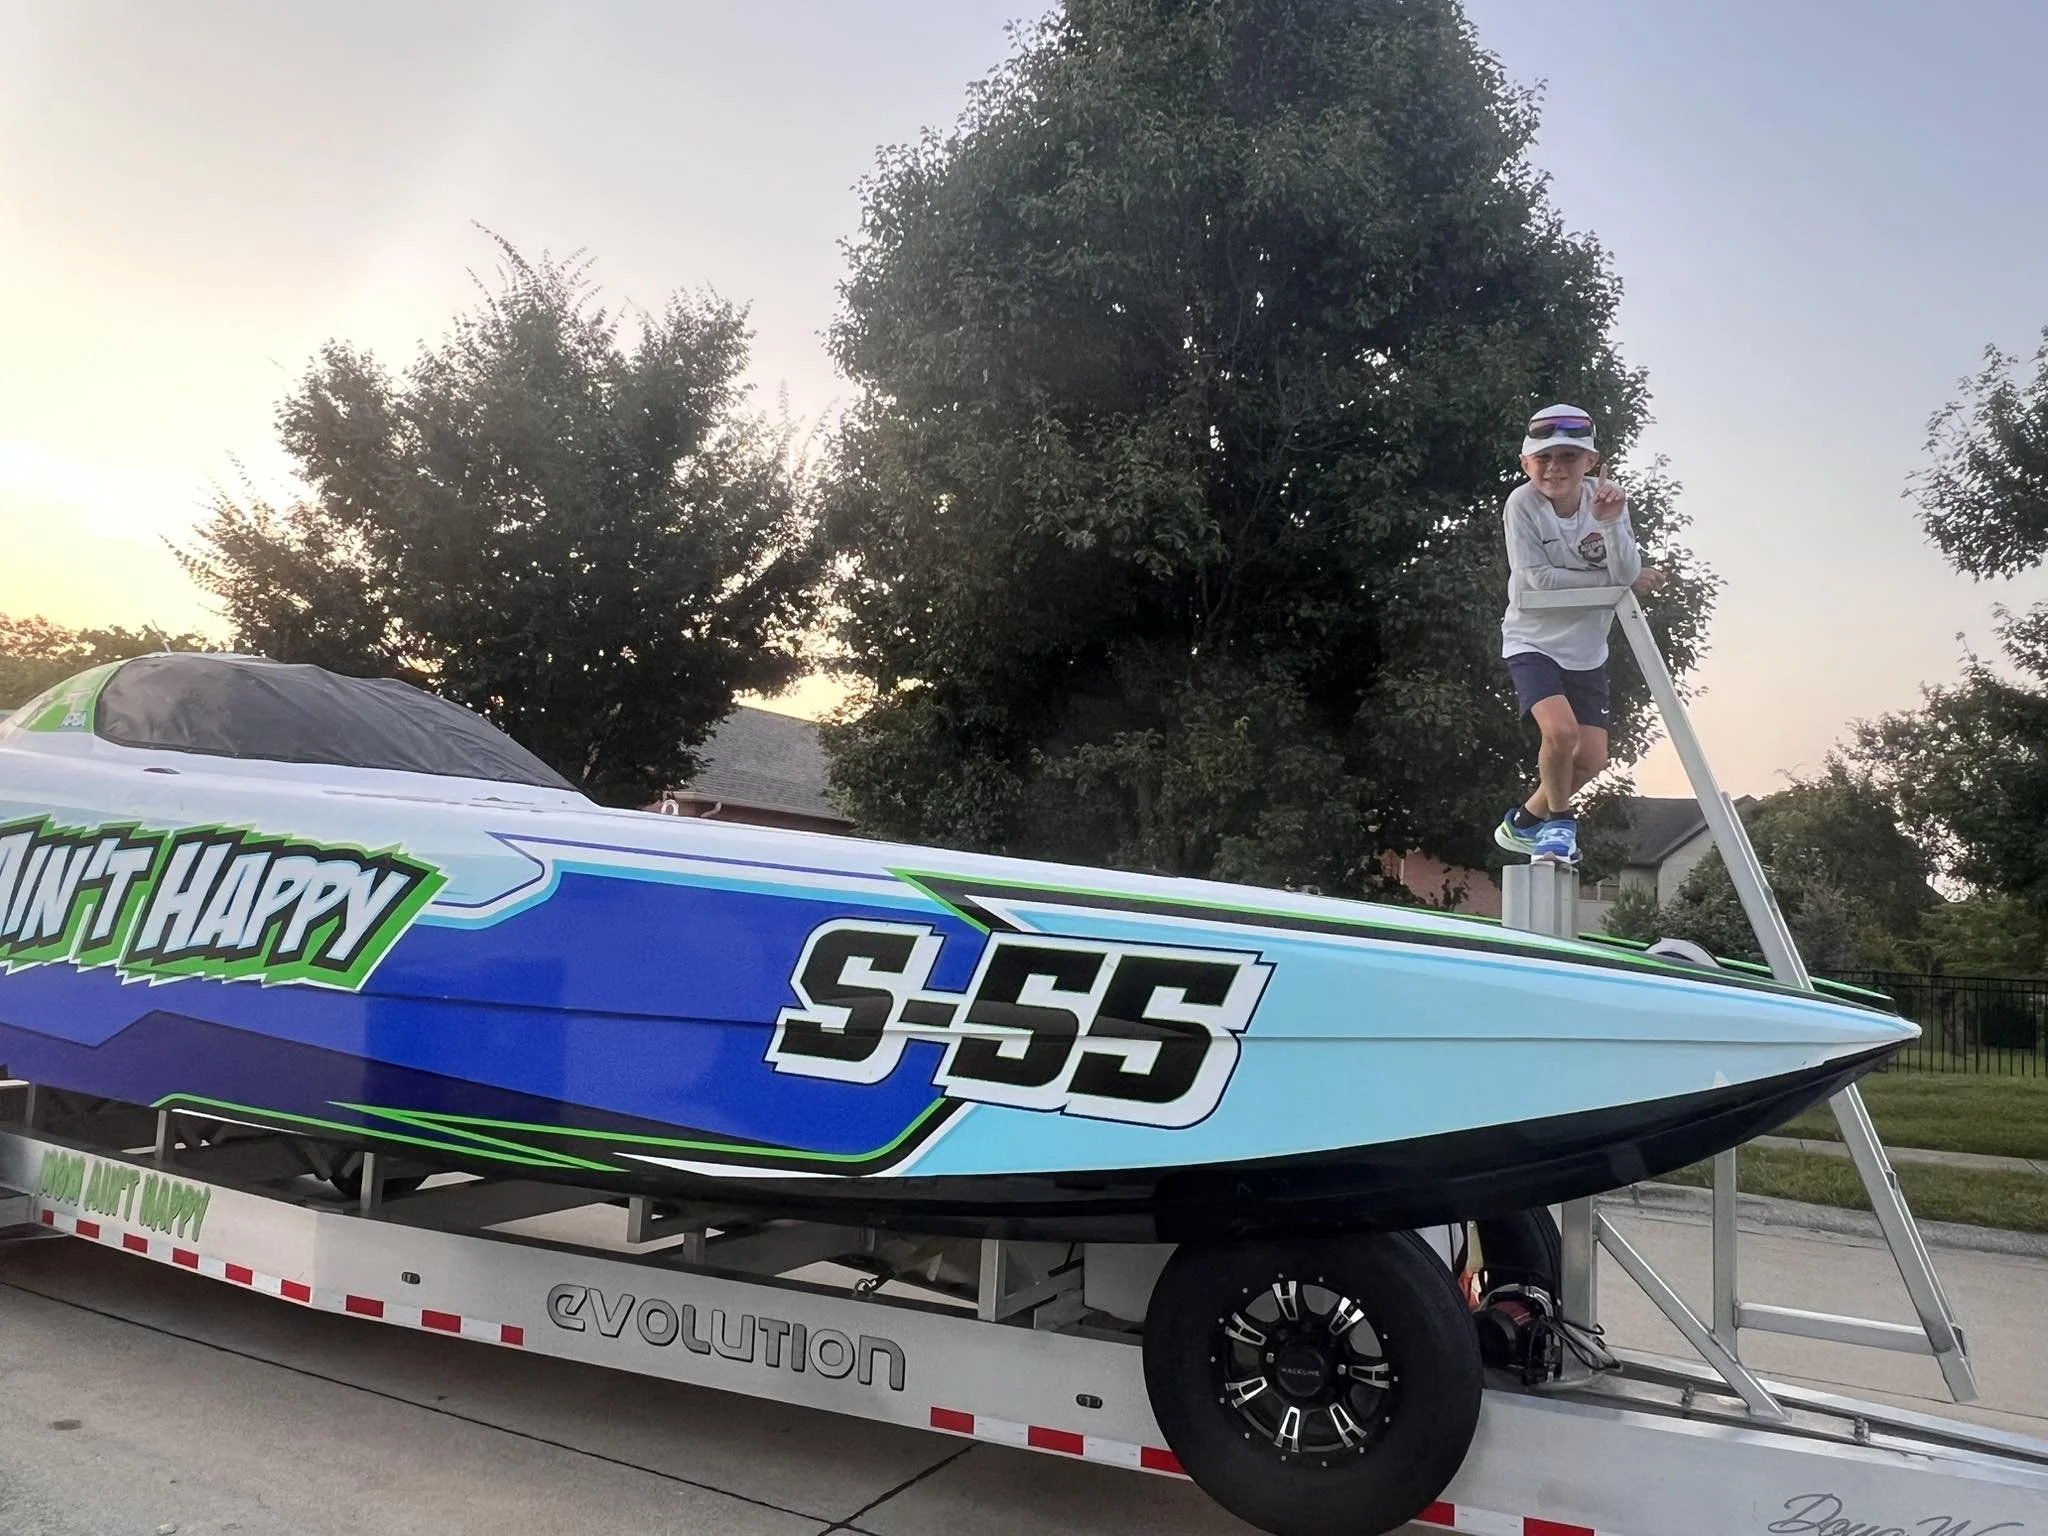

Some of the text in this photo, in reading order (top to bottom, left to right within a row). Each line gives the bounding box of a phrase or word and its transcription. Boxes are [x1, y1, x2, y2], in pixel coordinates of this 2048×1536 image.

[0, 831, 411, 961] AIN'T HAPPY
[776, 928, 1242, 1105] S-55
[139, 1172, 211, 1242] HAPPY
